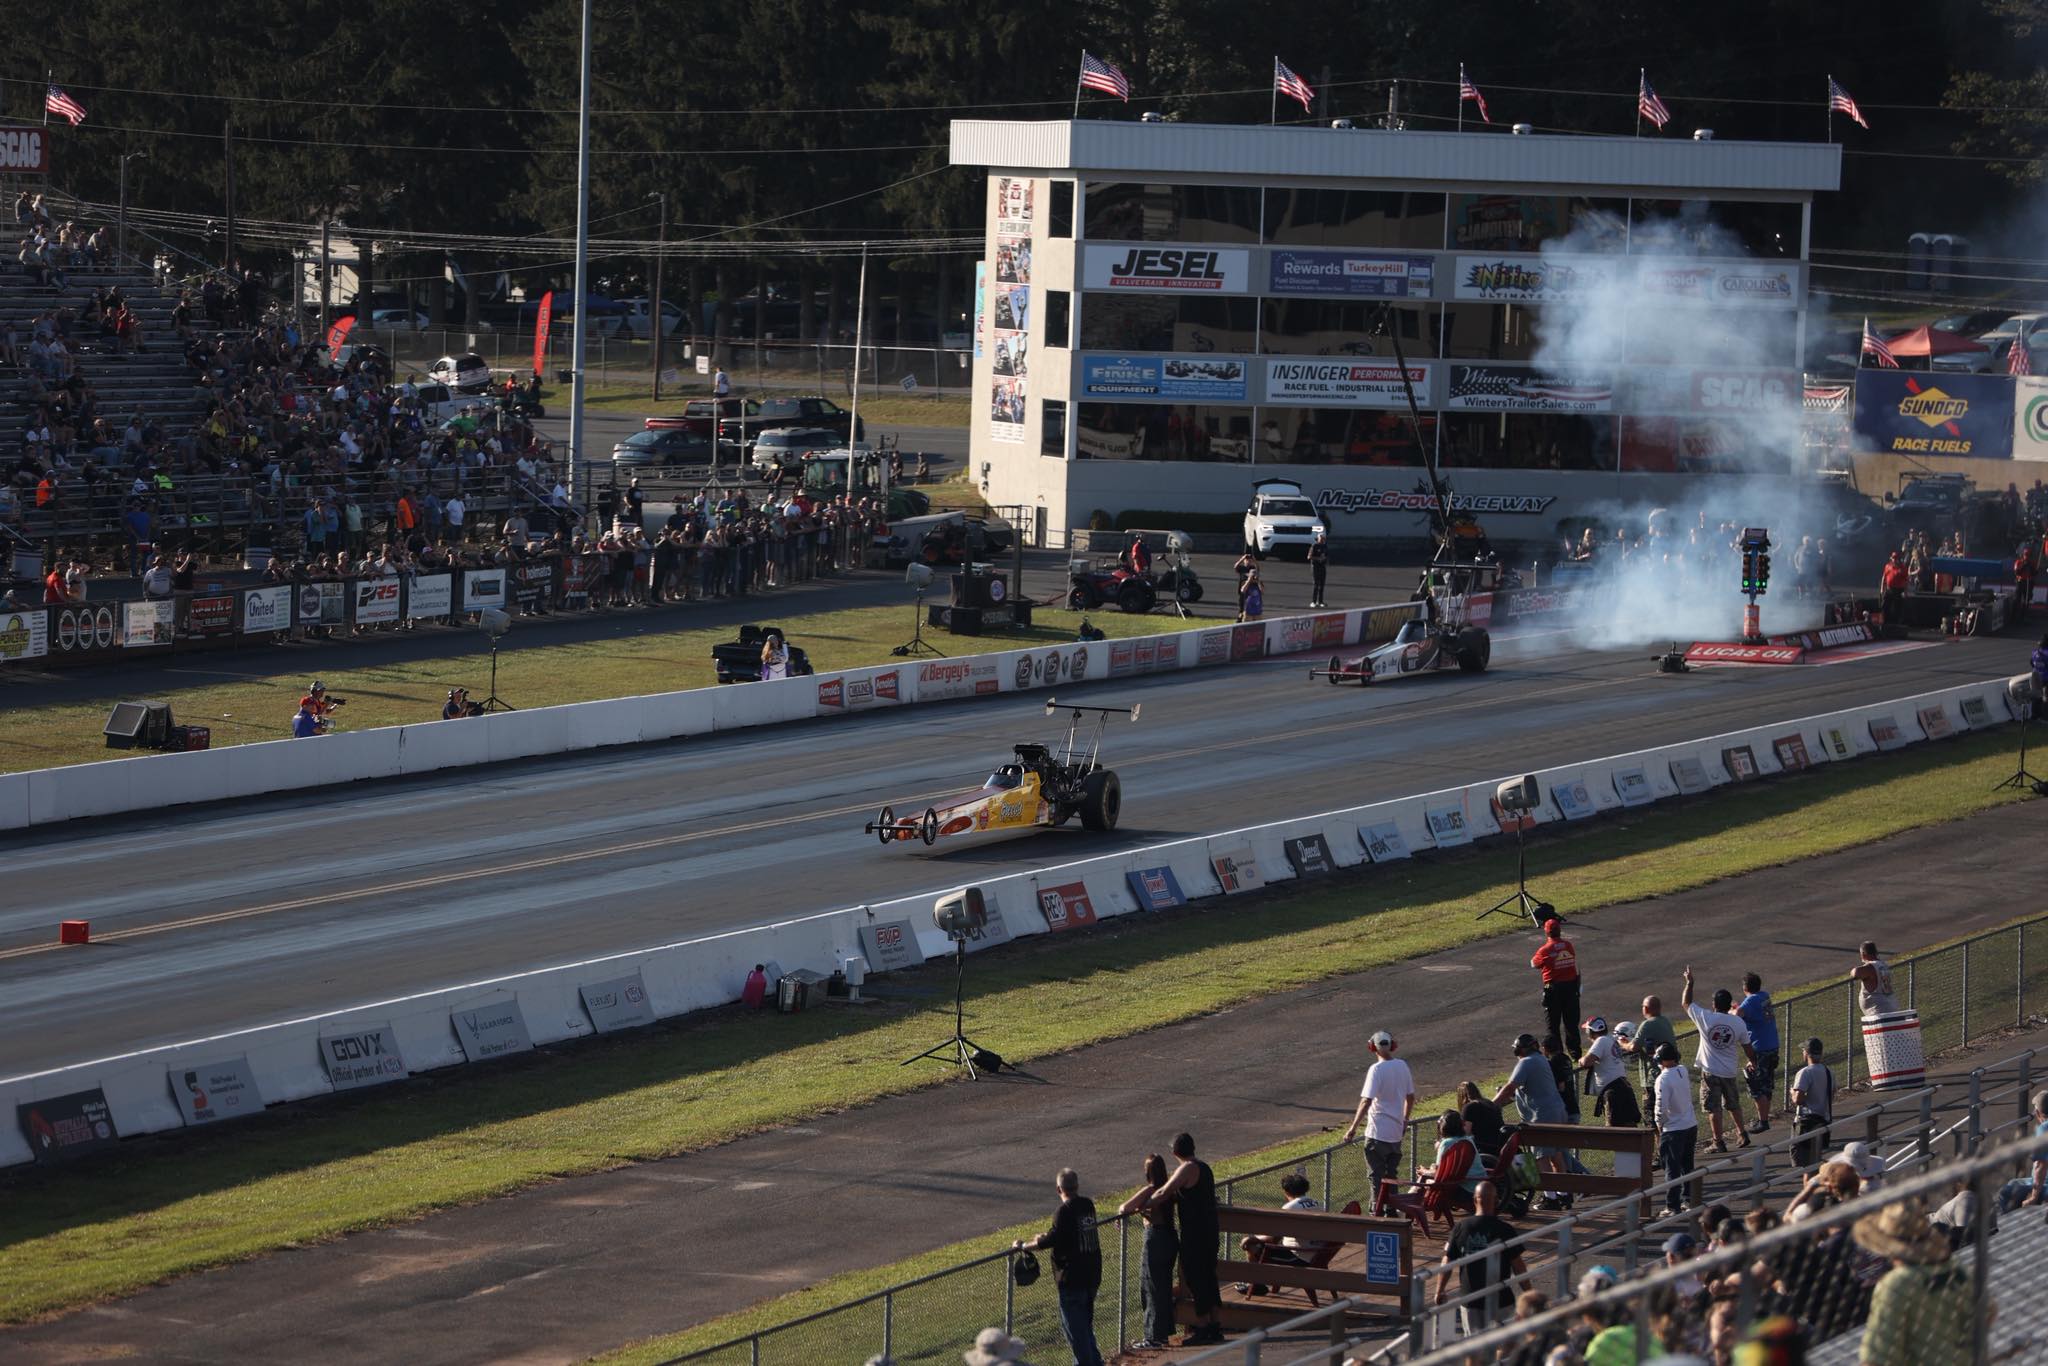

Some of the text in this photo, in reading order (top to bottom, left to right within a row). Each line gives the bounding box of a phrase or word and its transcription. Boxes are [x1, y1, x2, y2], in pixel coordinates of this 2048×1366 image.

[0, 131, 41, 168] SCAG
[1112, 249, 1225, 279] JESEL
[1284, 262, 1341, 275] Rewards
[1115, 278, 1217, 288] VALVETRAIN INNOVATION
[1723, 278, 1777, 291] CAROLINE
[1092, 366, 1157, 380] FINKE
[1272, 364, 1350, 381] INSINGER
[1461, 366, 1521, 385] Winters
[1090, 385, 1156, 394] EQUIPMENT
[1284, 383, 1307, 391] RACE
[1308, 384, 1330, 392] FUEL
[1335, 384, 1385, 393] INDUSTRIAL
[1463, 397, 1598, 410] WintersTrailerSales.com
[1901, 399, 1966, 417] SUNOCO
[1892, 437, 1972, 453] RACE FUELS
[248, 599, 275, 618] United
[1689, 646, 1795, 660] LUCAS OIL
[928, 662, 971, 684] Bergey's
[331, 1033, 387, 1061] GOVX
